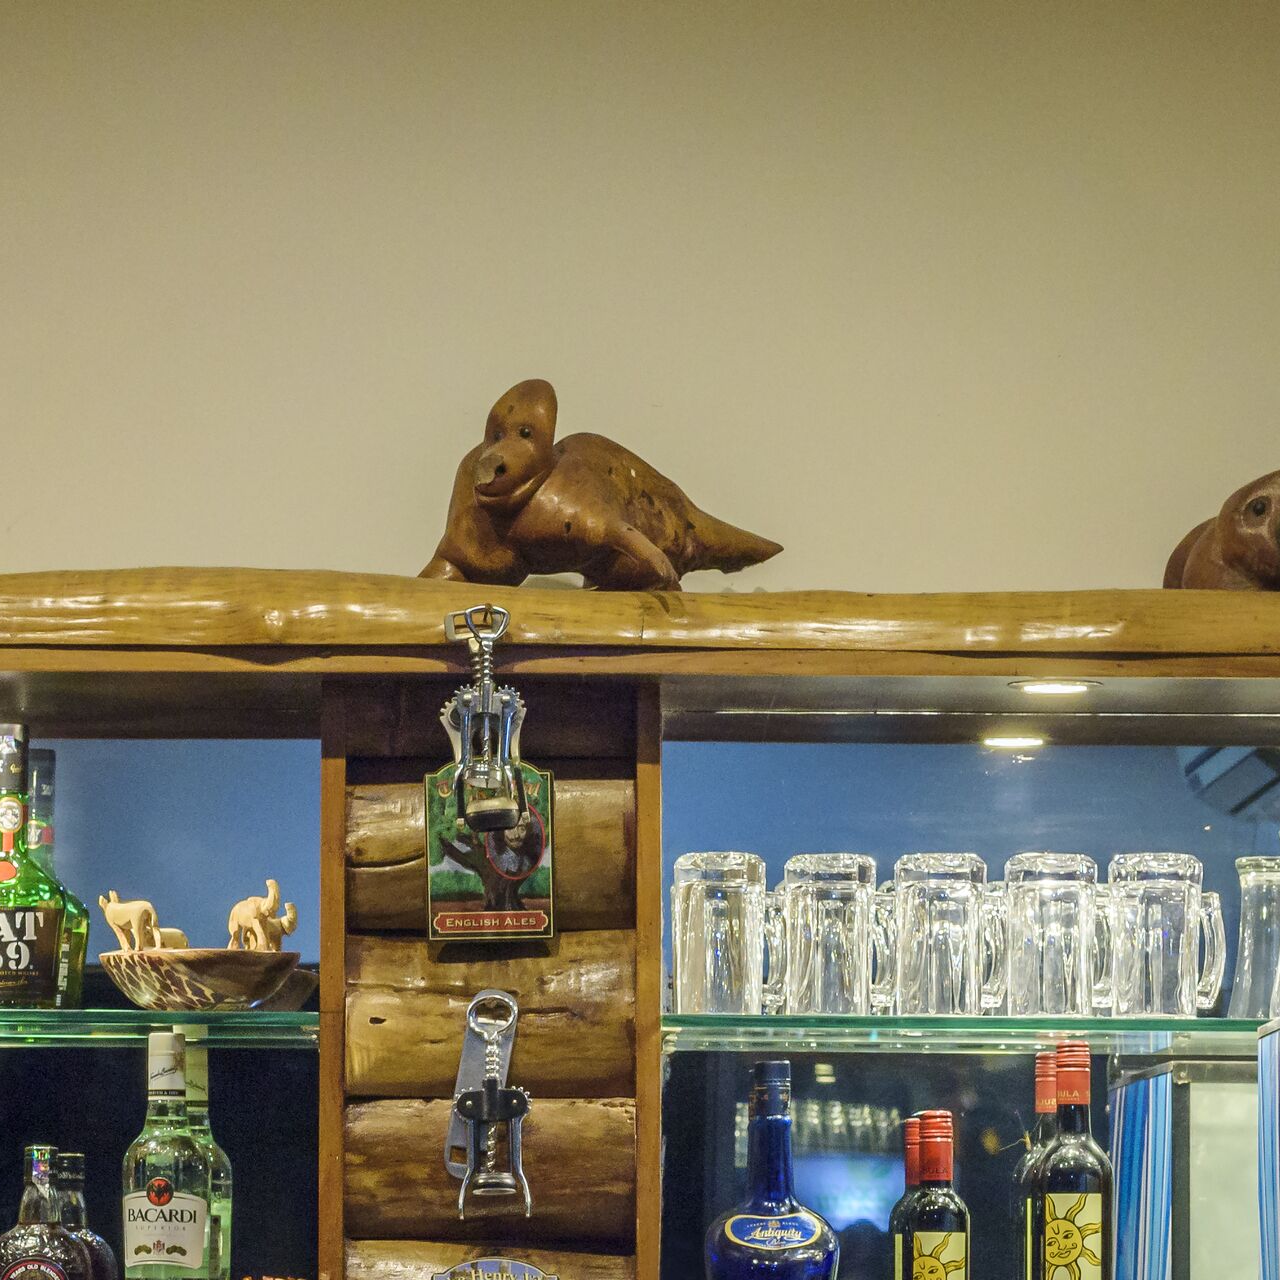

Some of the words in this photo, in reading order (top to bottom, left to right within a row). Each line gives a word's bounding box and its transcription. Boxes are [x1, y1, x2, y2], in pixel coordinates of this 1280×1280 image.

[446, 917, 500, 927] ENGLISH
[504, 916, 536, 926] ALES
[127, 1207, 197, 1224] BACARDI
[749, 1227, 802, 1239] Antiquity
